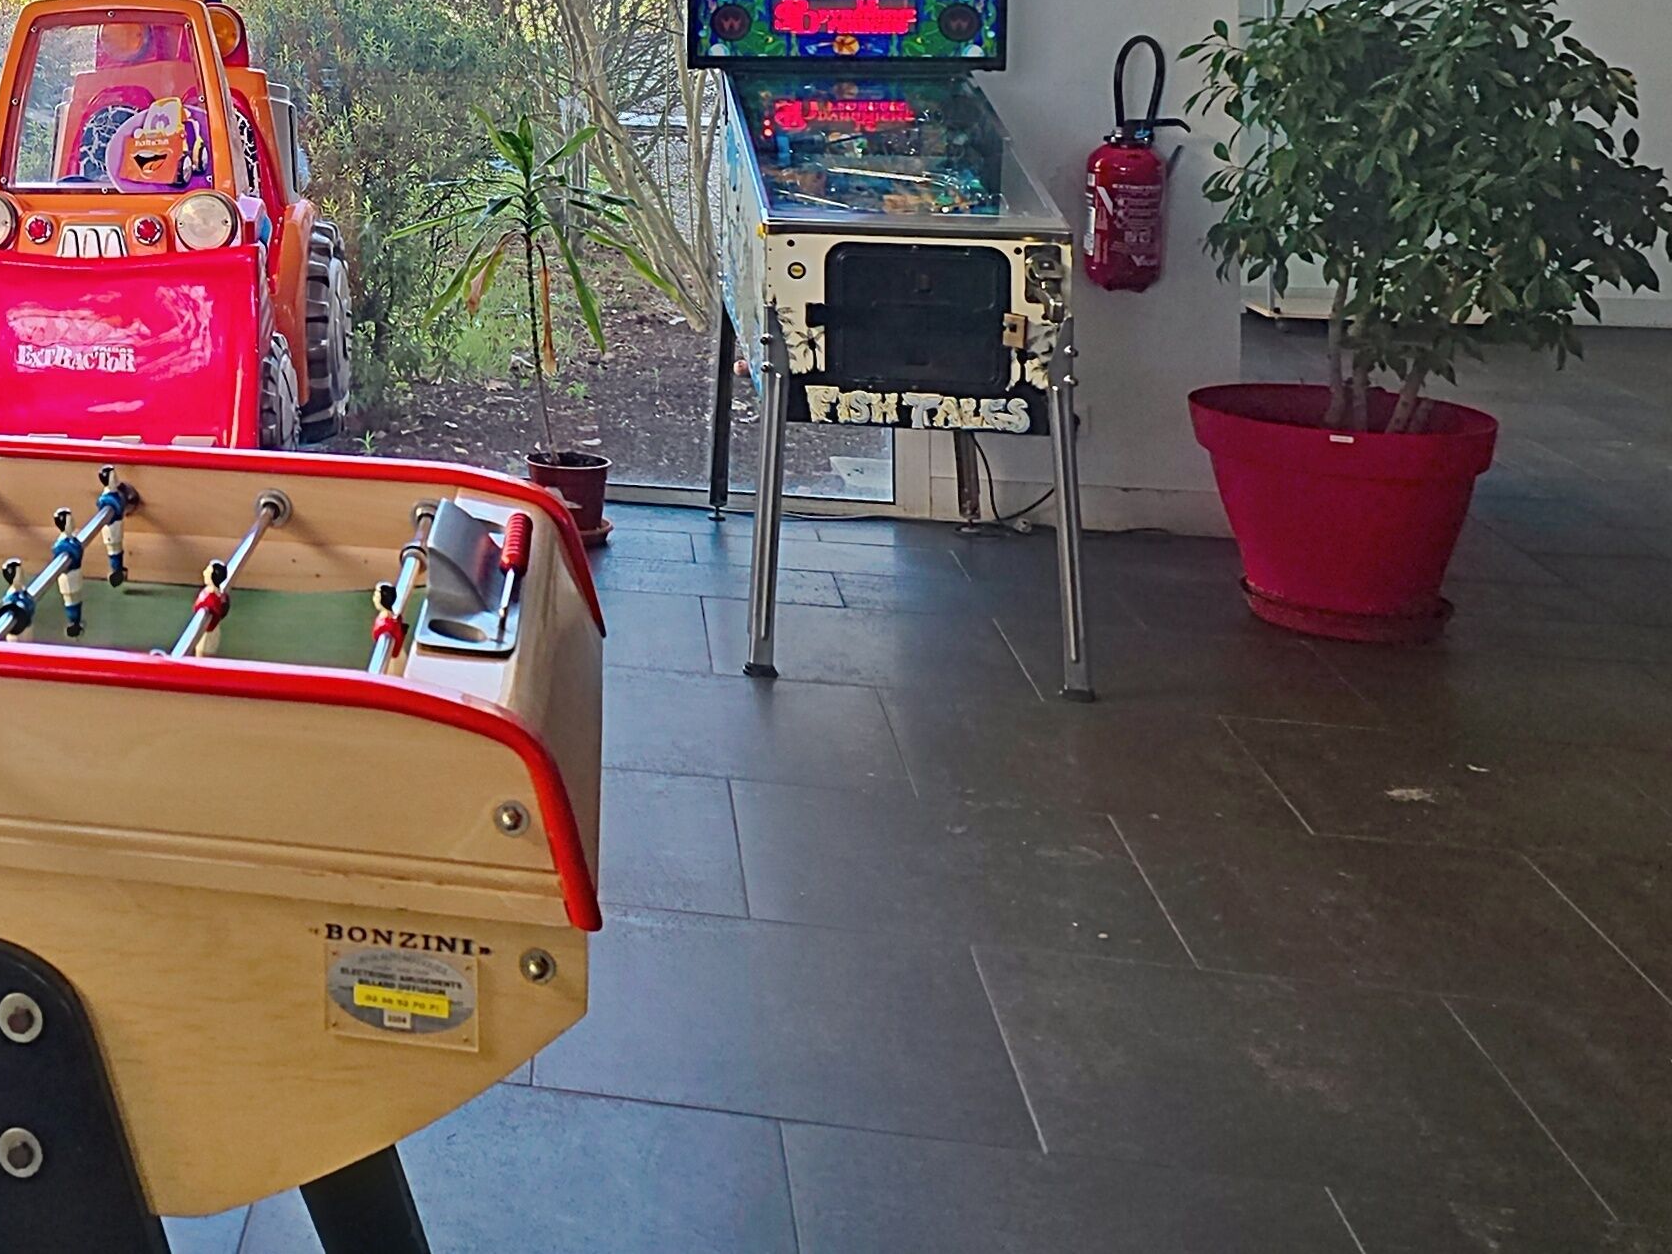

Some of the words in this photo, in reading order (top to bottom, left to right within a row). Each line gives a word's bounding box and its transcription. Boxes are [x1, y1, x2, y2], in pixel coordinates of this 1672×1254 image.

[17, 344, 137, 373] EXTRACTOR
[805, 385, 899, 423] FISH
[901, 392, 1030, 433] TALES
[325, 923, 475, 956] BONZINI
